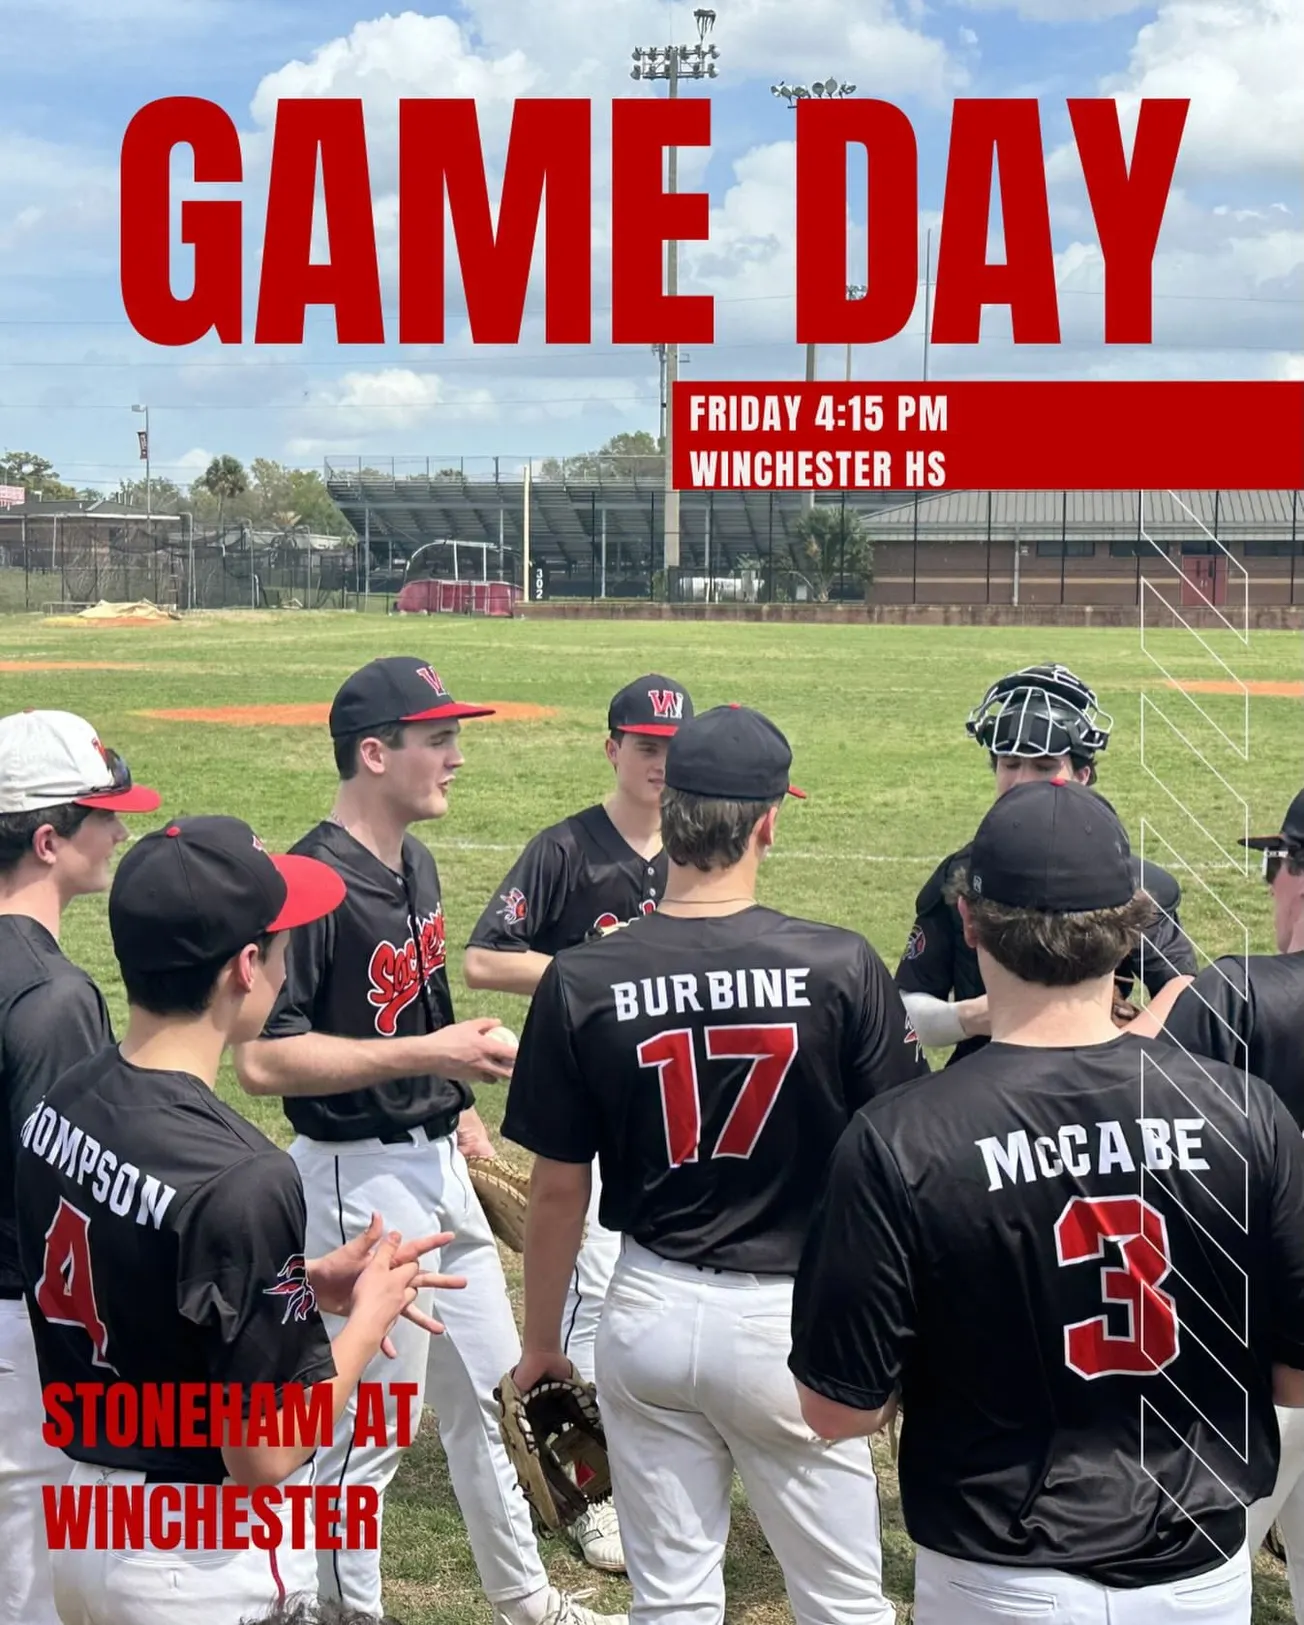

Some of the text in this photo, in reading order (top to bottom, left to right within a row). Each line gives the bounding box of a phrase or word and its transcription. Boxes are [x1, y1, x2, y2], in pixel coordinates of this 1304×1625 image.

[535, 568, 544, 600] 302
[647, 689, 684, 720] W
[610, 967, 812, 1022] BURBINE
[636, 1022, 799, 1169] 17
[974, 1117, 1211, 1193] McCABE
[34, 1195, 121, 1378] 4
[1053, 1194, 1181, 1381] 3
